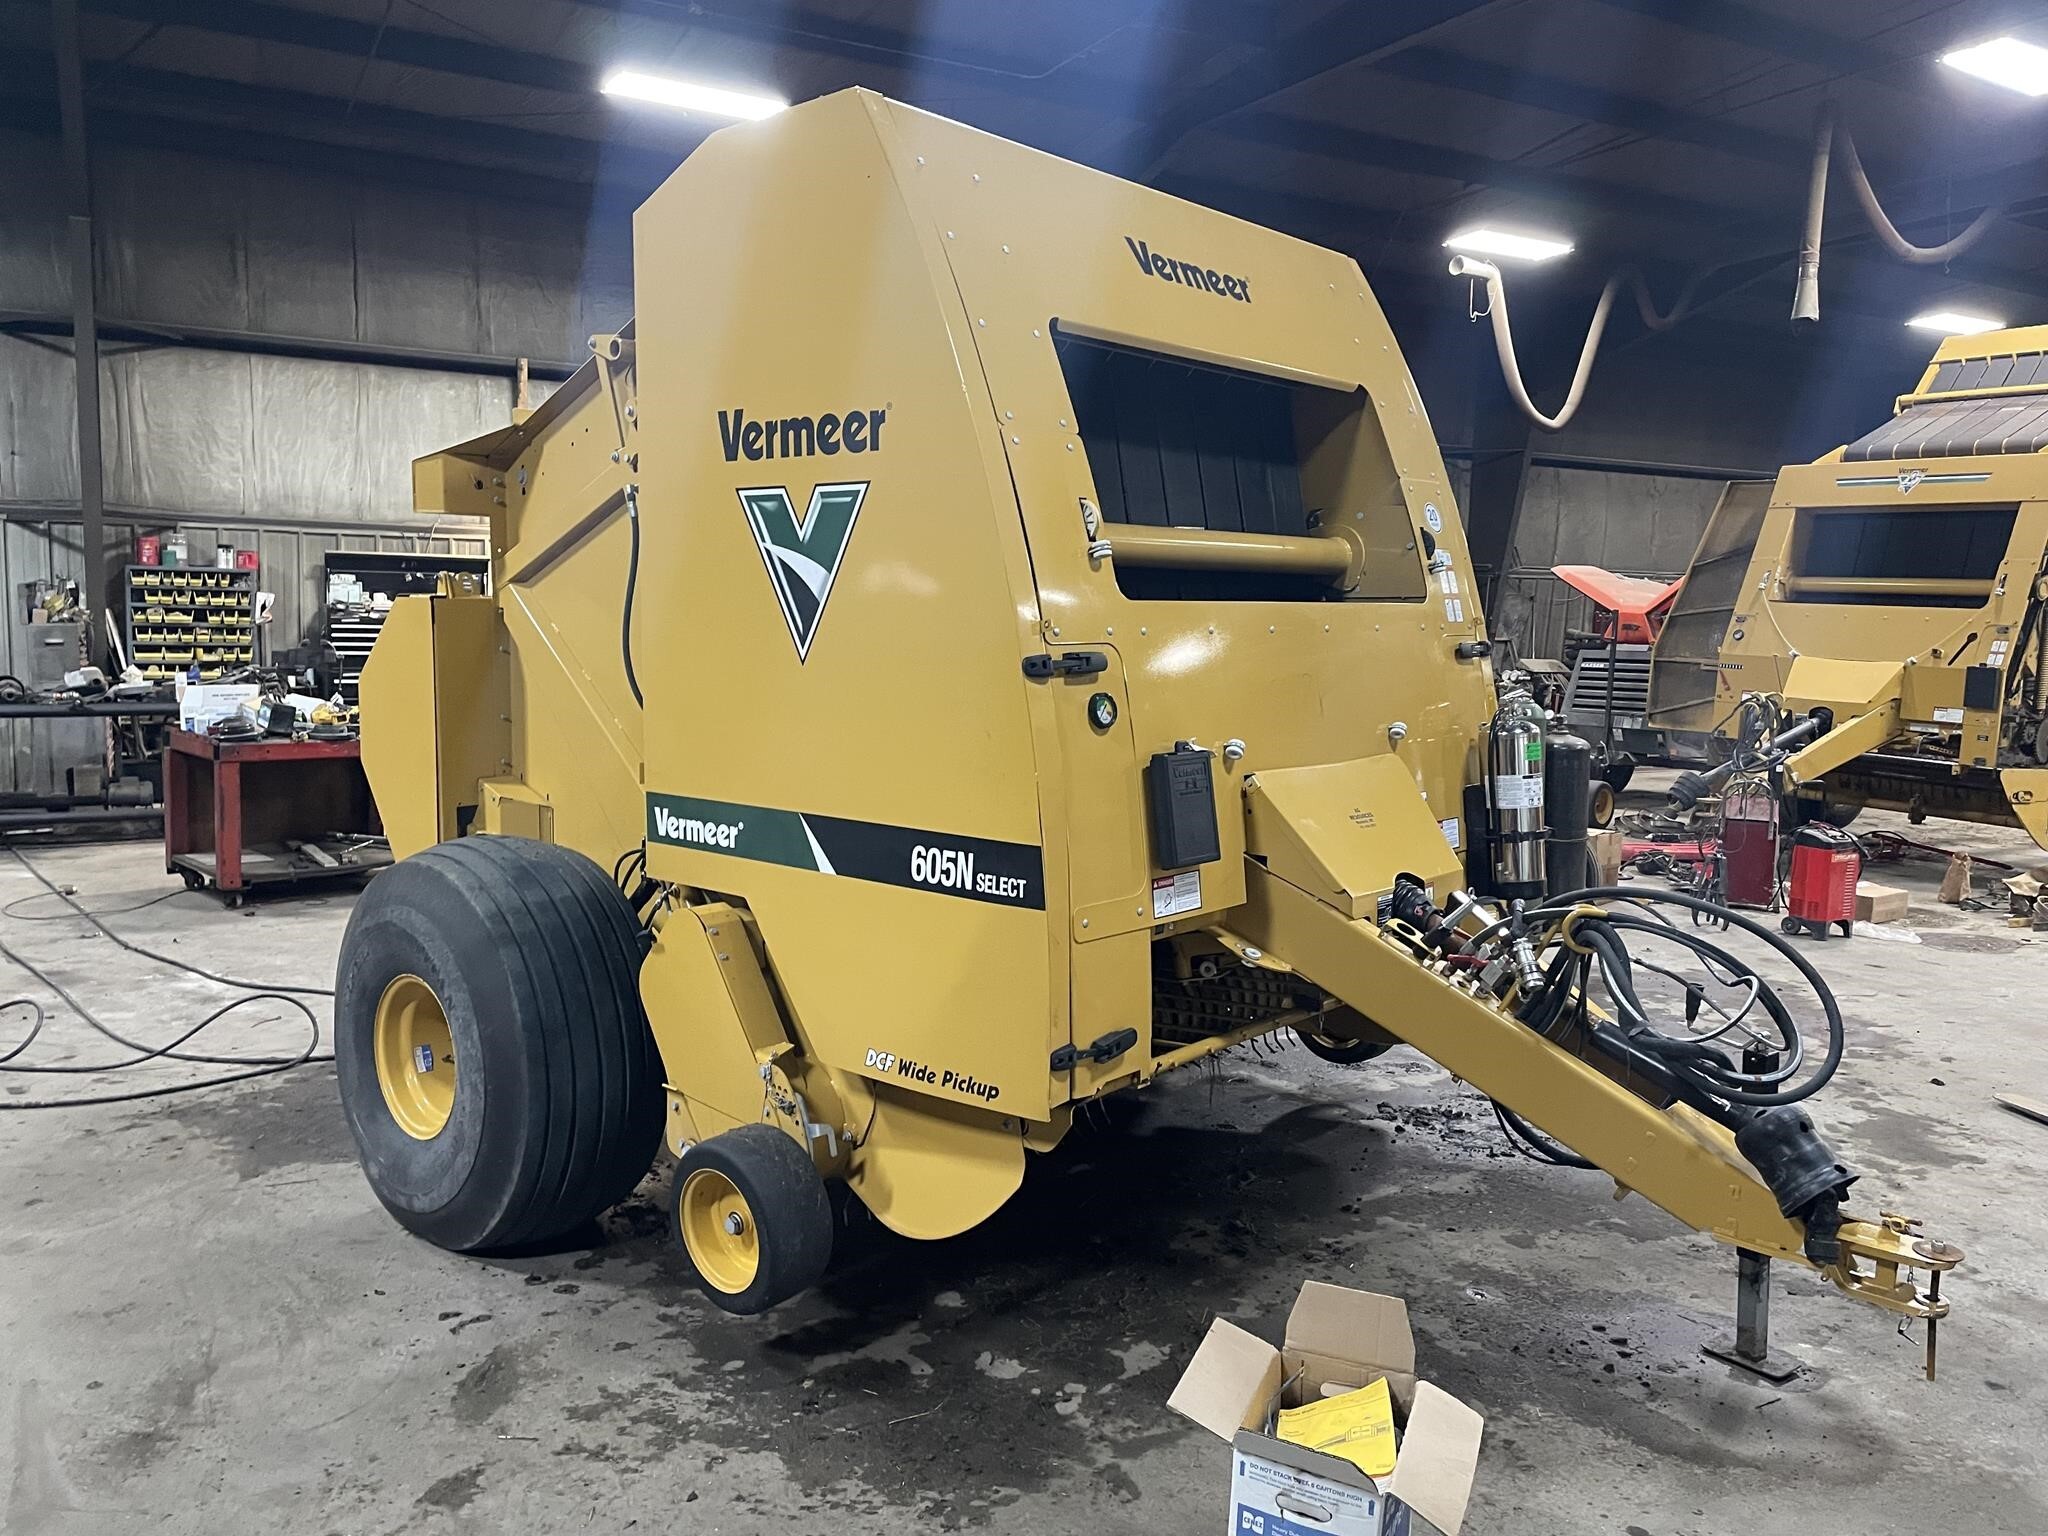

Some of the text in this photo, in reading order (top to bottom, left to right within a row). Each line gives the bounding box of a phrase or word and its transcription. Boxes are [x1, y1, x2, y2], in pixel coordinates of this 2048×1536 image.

[911, 845, 1026, 899] 605N SELECT
[864, 1048, 1000, 1101] DCF Wide Pickup
[1250, 1462, 1259, 1470] DO
[1260, 1466, 1272, 1474] NOT
[1273, 1470, 1292, 1481] STACK
[1243, 1516, 1263, 1529] CENEX
